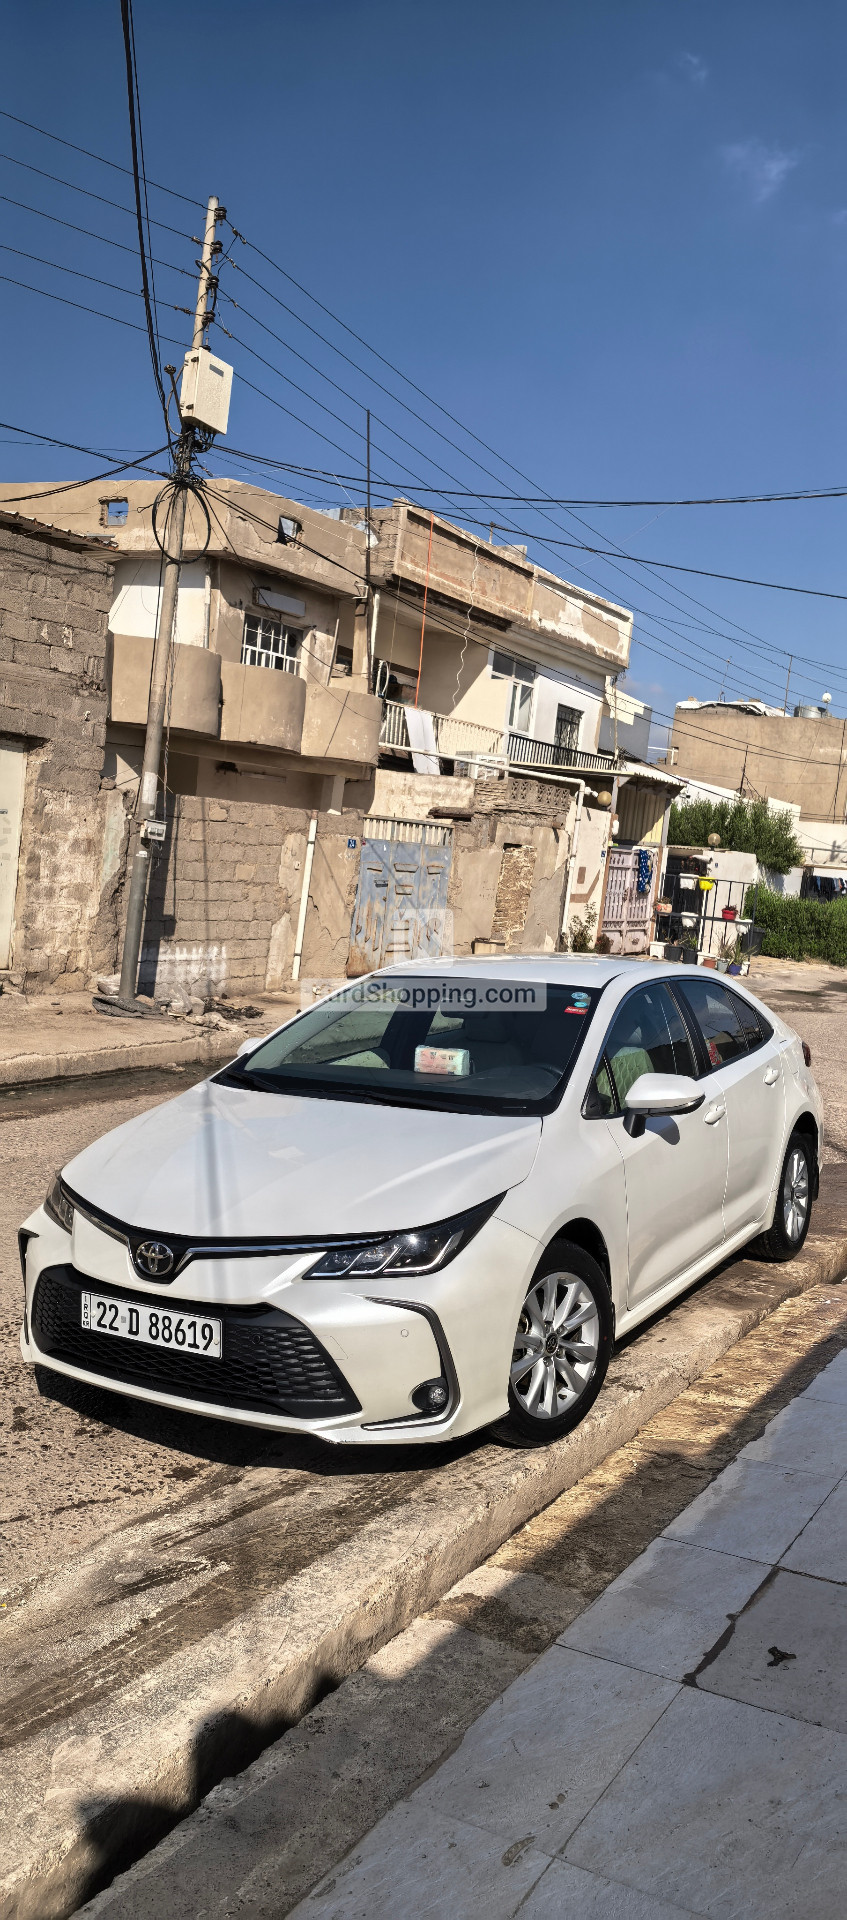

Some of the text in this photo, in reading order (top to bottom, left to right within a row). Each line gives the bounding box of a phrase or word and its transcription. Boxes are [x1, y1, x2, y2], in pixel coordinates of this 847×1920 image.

[97, 1301, 214, 1351] 22 D 88619
